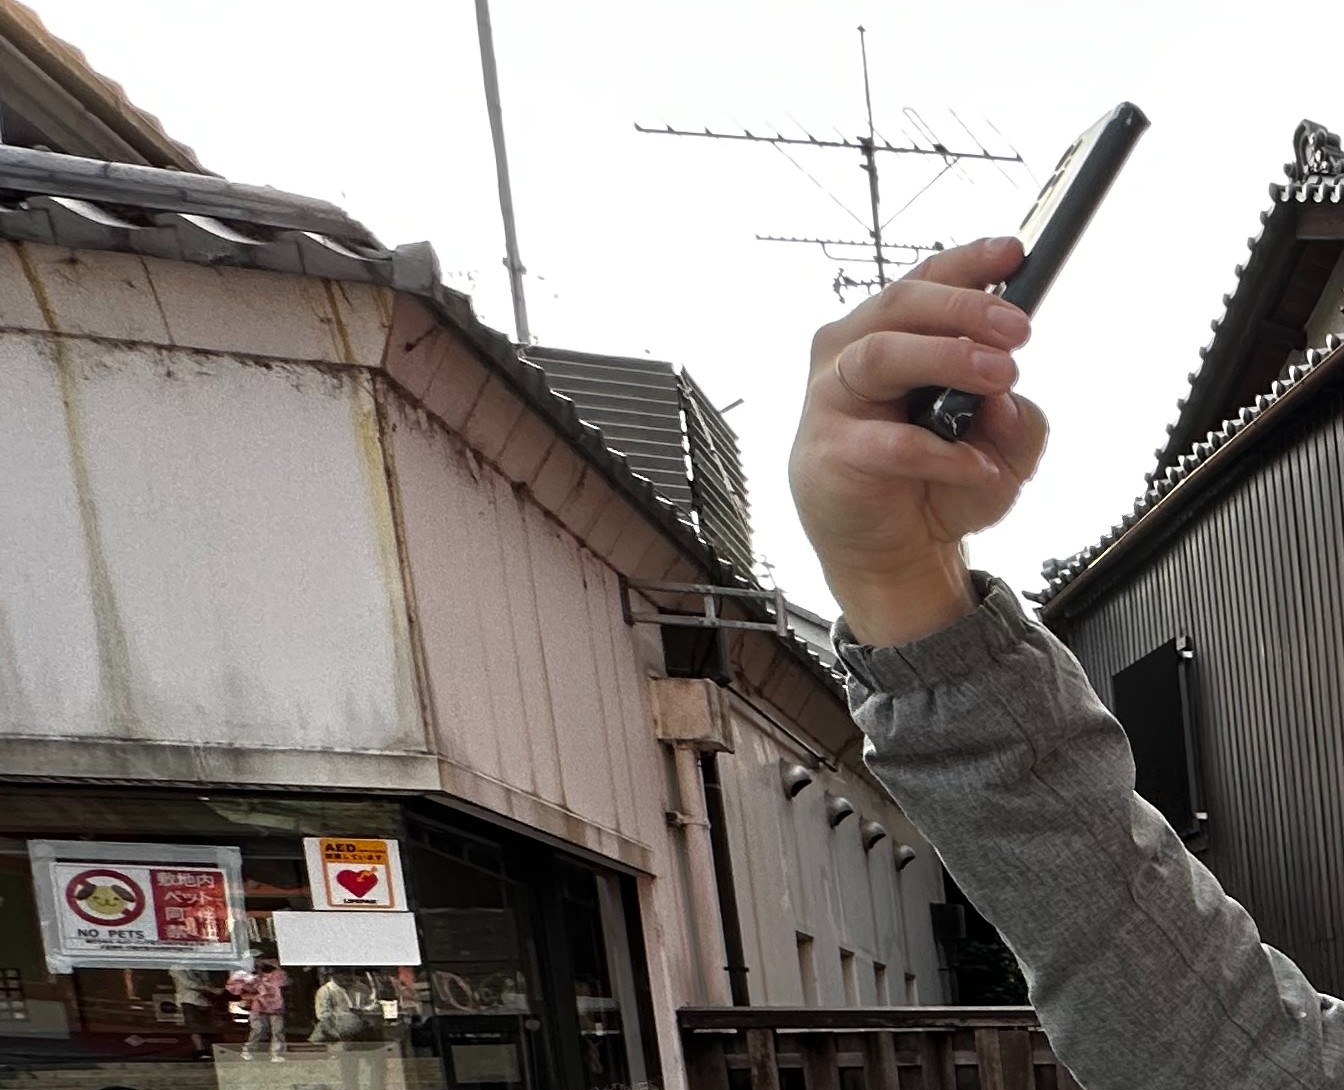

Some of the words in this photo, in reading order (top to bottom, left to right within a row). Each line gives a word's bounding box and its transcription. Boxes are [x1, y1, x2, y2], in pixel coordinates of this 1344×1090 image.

[325, 843, 356, 852] AED
[77, 928, 99, 938] NO
[108, 929, 145, 940] PETS
